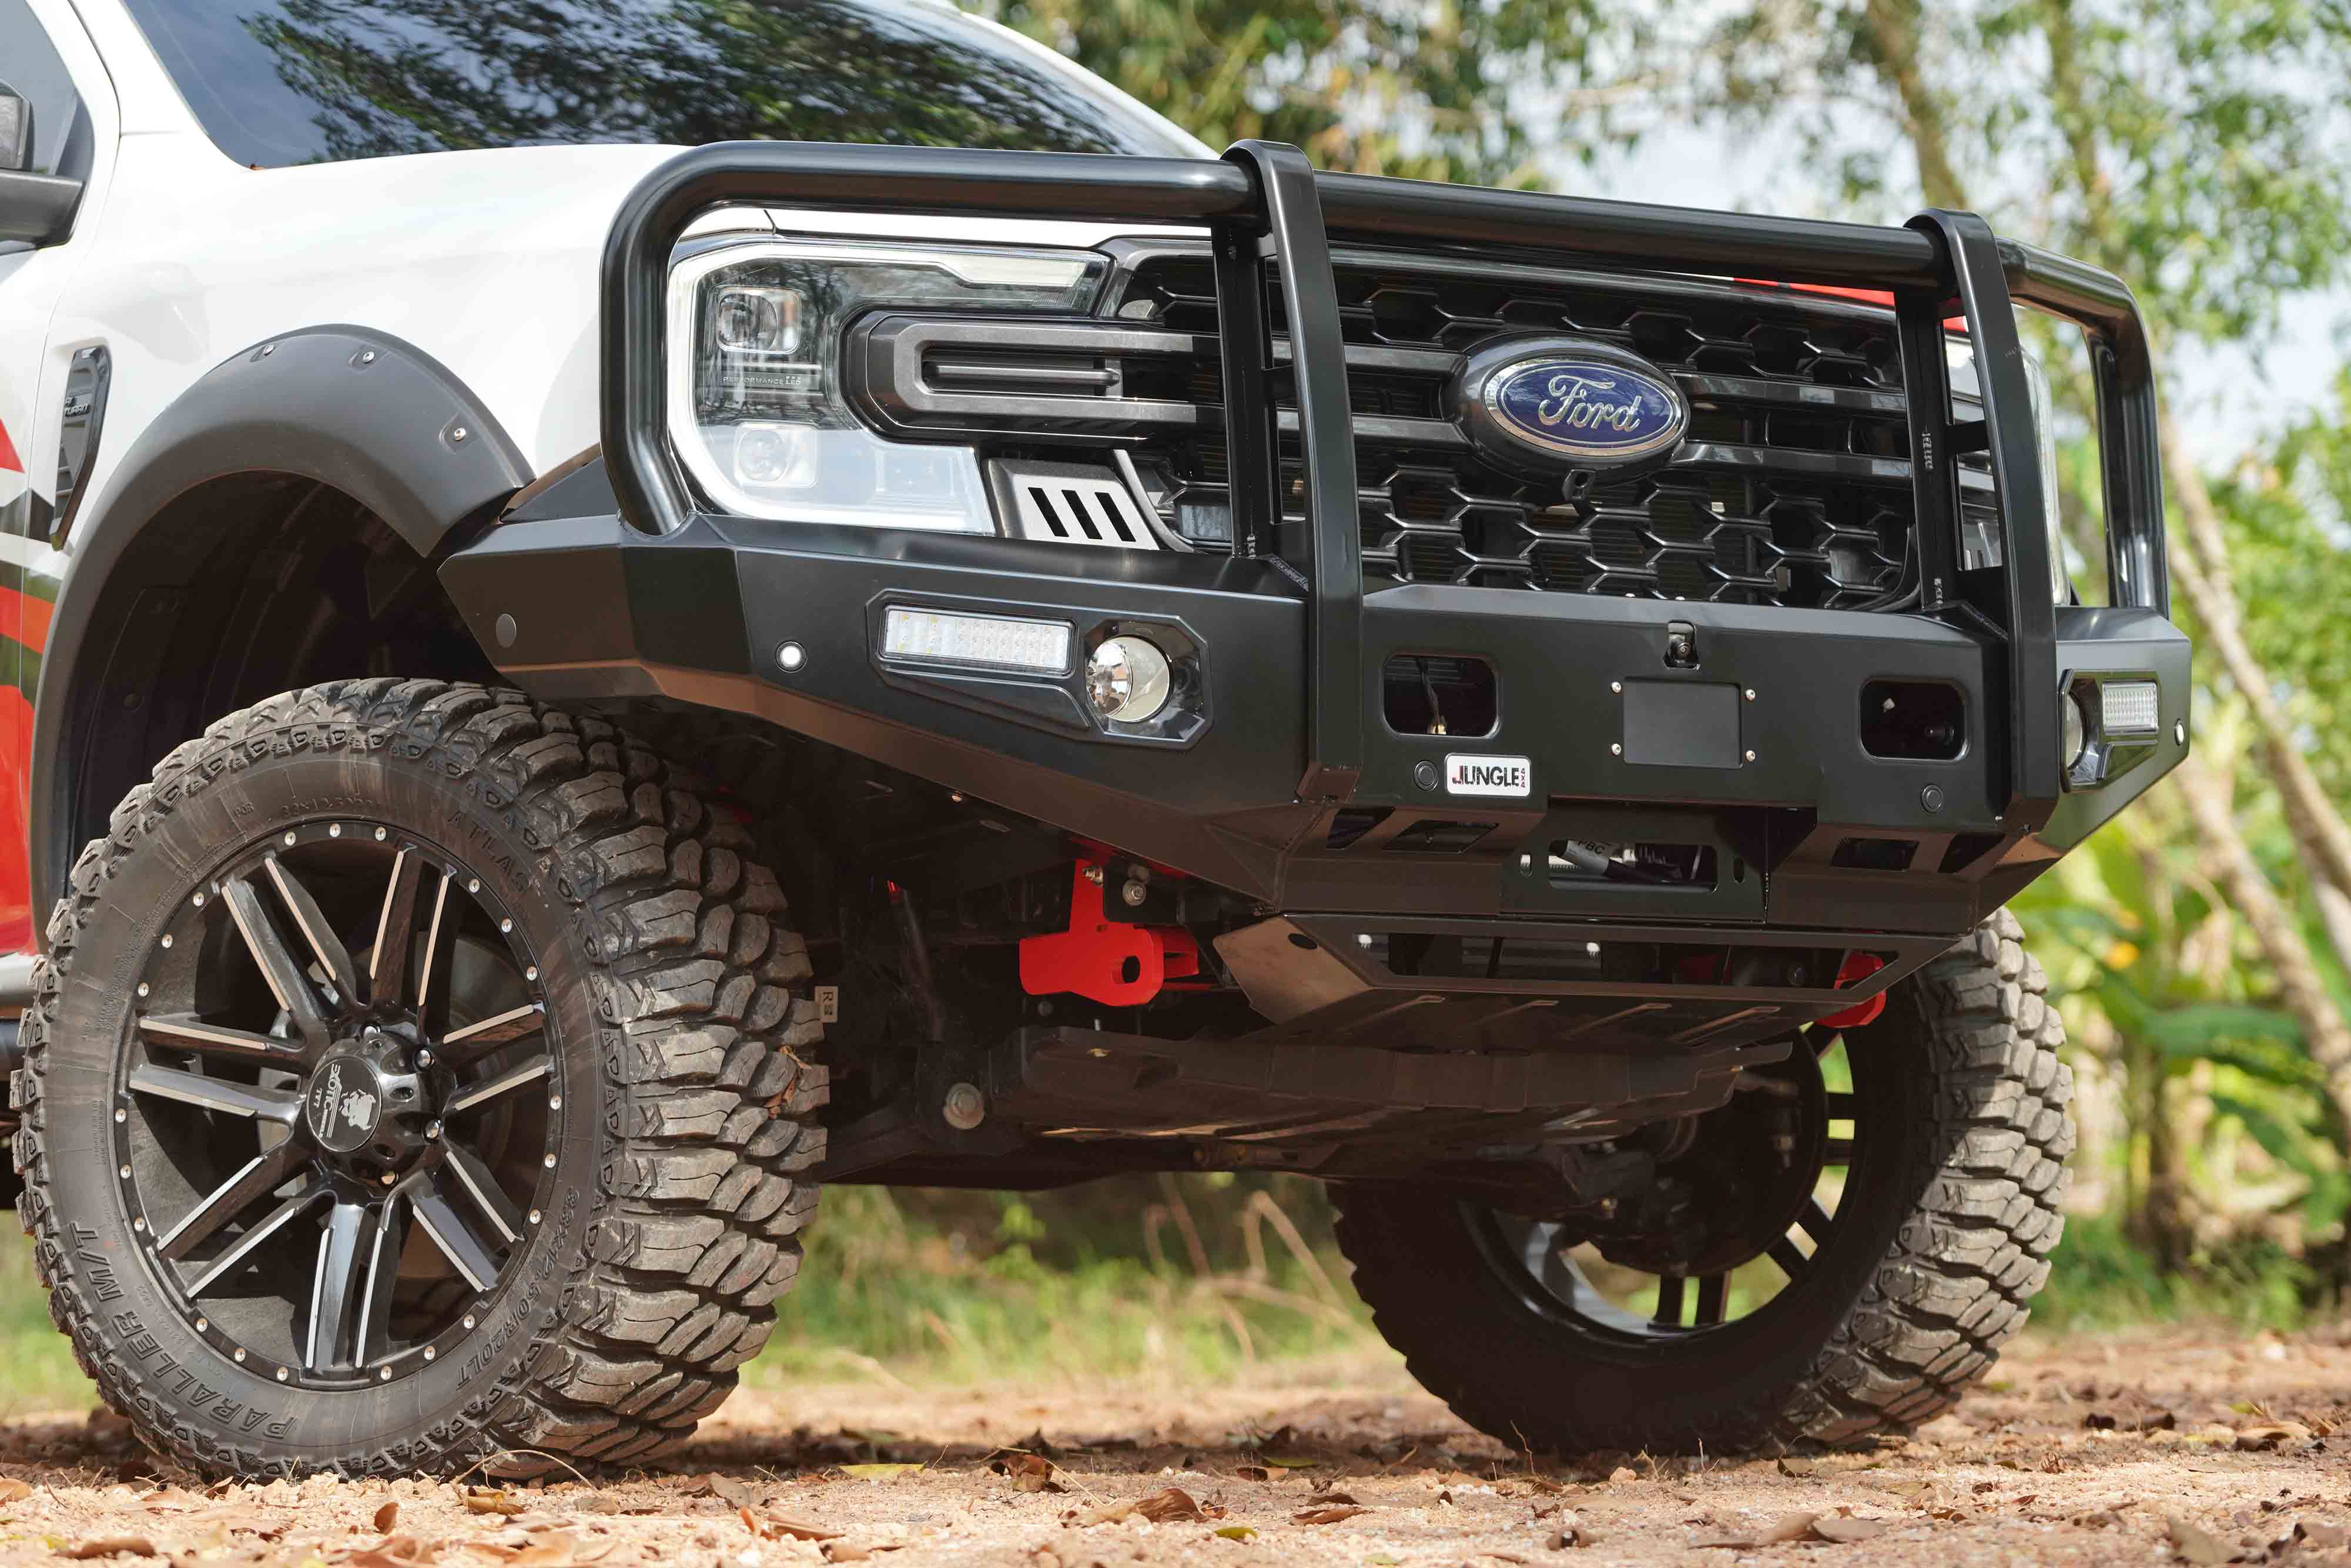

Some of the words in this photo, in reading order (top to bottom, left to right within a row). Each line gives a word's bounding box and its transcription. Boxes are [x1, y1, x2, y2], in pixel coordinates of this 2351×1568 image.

[724, 376, 783, 385] PERORMANCE
[1538, 374, 1642, 433] Ford
[1452, 765, 1519, 787] JUNGLE
[448, 809, 531, 893] ATLAS
[324, 1063, 342, 1111] EXOTIC
[68, 1221, 125, 1302] M/T
[113, 1310, 296, 1439] PARALLER
